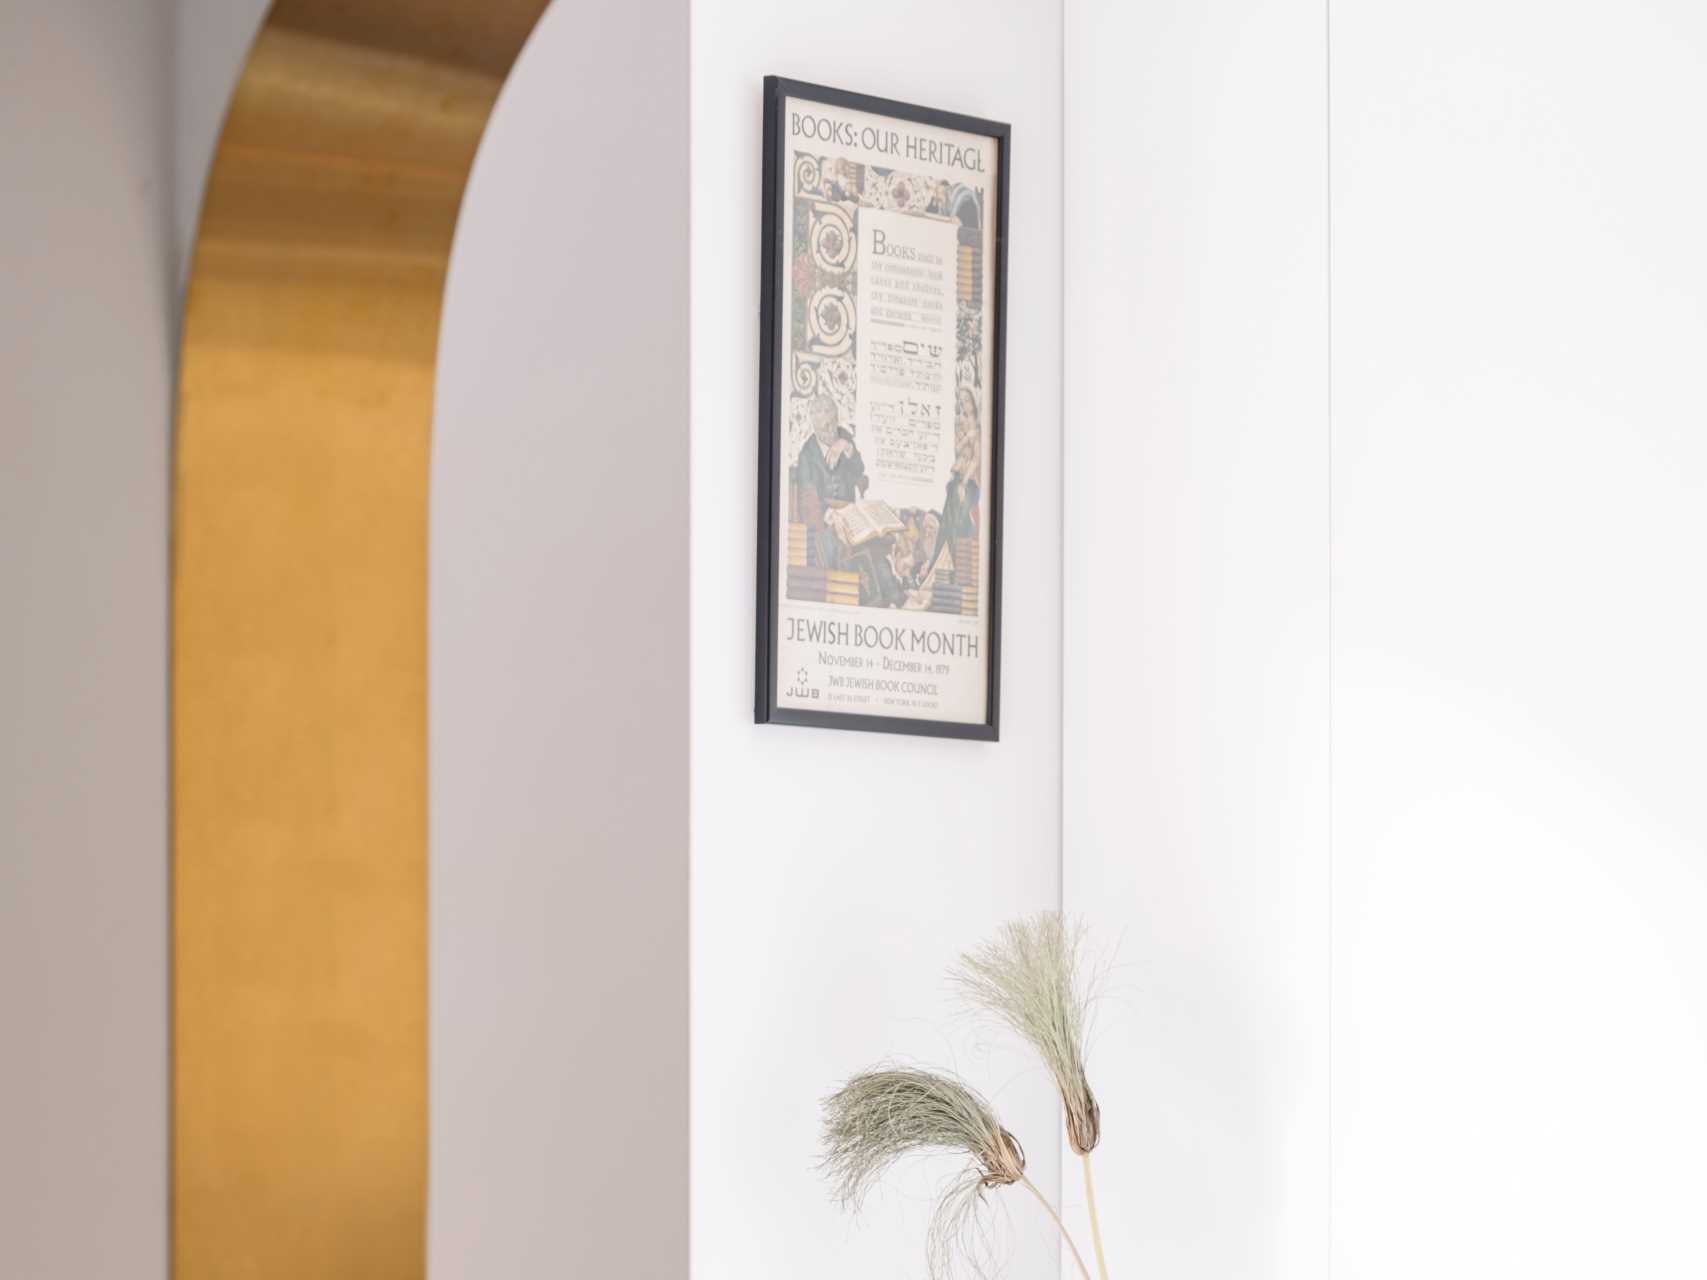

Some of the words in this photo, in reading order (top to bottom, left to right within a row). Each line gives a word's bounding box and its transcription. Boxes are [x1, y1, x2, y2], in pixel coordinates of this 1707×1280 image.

[791, 112, 858, 148] BOOKS:
[861, 127, 900, 156] OUR
[786, 617, 849, 646] JEWISH
[854, 623, 906, 652] BOOK
[911, 629, 979, 658] MONTH
[846, 676, 874, 690] JEWISH
[875, 680, 900, 692] BOOK
[901, 681, 939, 696] COUNCIL
